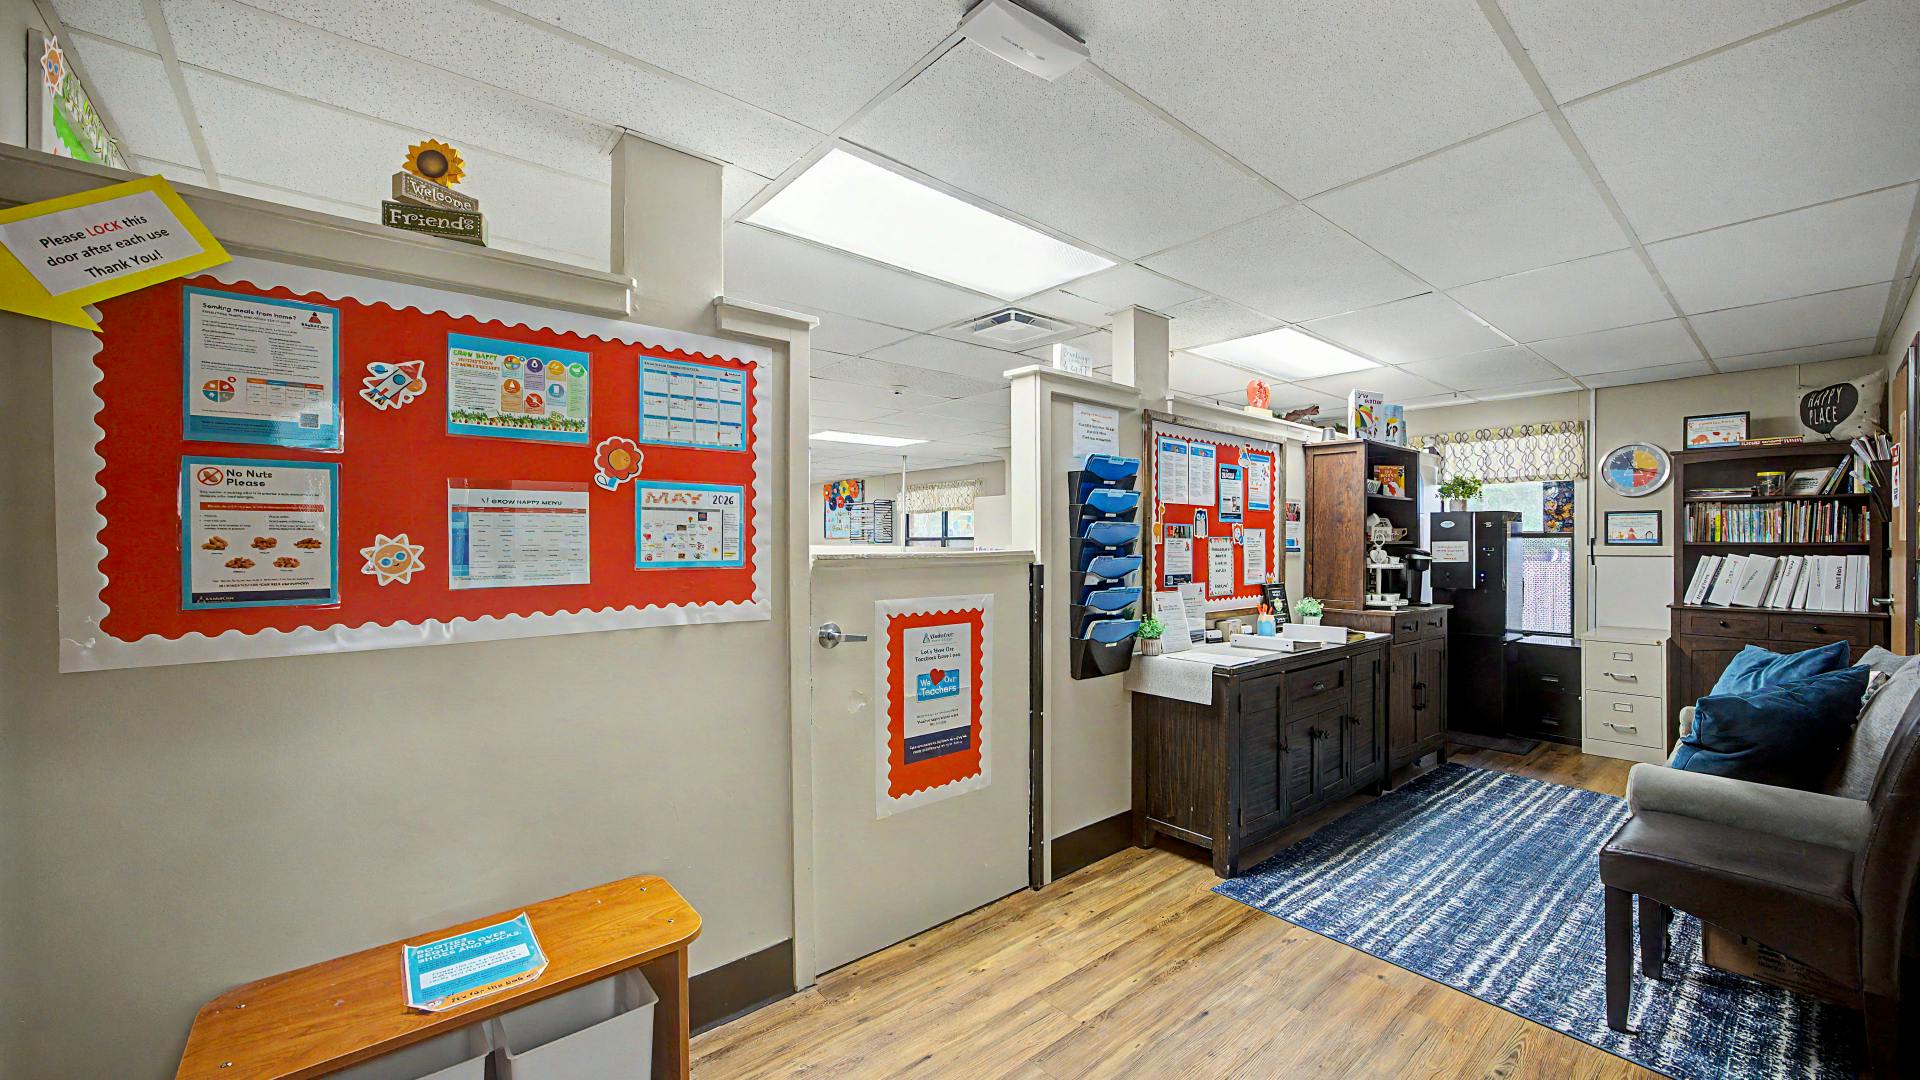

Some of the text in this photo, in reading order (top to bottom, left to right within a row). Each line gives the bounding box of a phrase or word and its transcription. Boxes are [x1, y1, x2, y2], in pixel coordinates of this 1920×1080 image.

[410, 180, 472, 211] Welcome
[389, 208, 474, 230] Friends
[39, 215, 148, 249] Please LOCK this
[46, 228, 170, 267] door after each use
[84, 249, 164, 279] Thank You!
[256, 310, 273, 318] from
[1807, 386, 1843, 408] HAPPY
[1809, 406, 1838, 426] PLACE
[226, 469, 273, 480] No Nuts
[226, 478, 266, 487] Please
[644, 491, 735, 506] MAY 2026
[920, 675, 957, 687] We Our
[921, 685, 957, 697] Teachers
[478, 930, 506, 941] OVER
[418, 950, 456, 964] SHOES
[458, 942, 482, 953] AND
